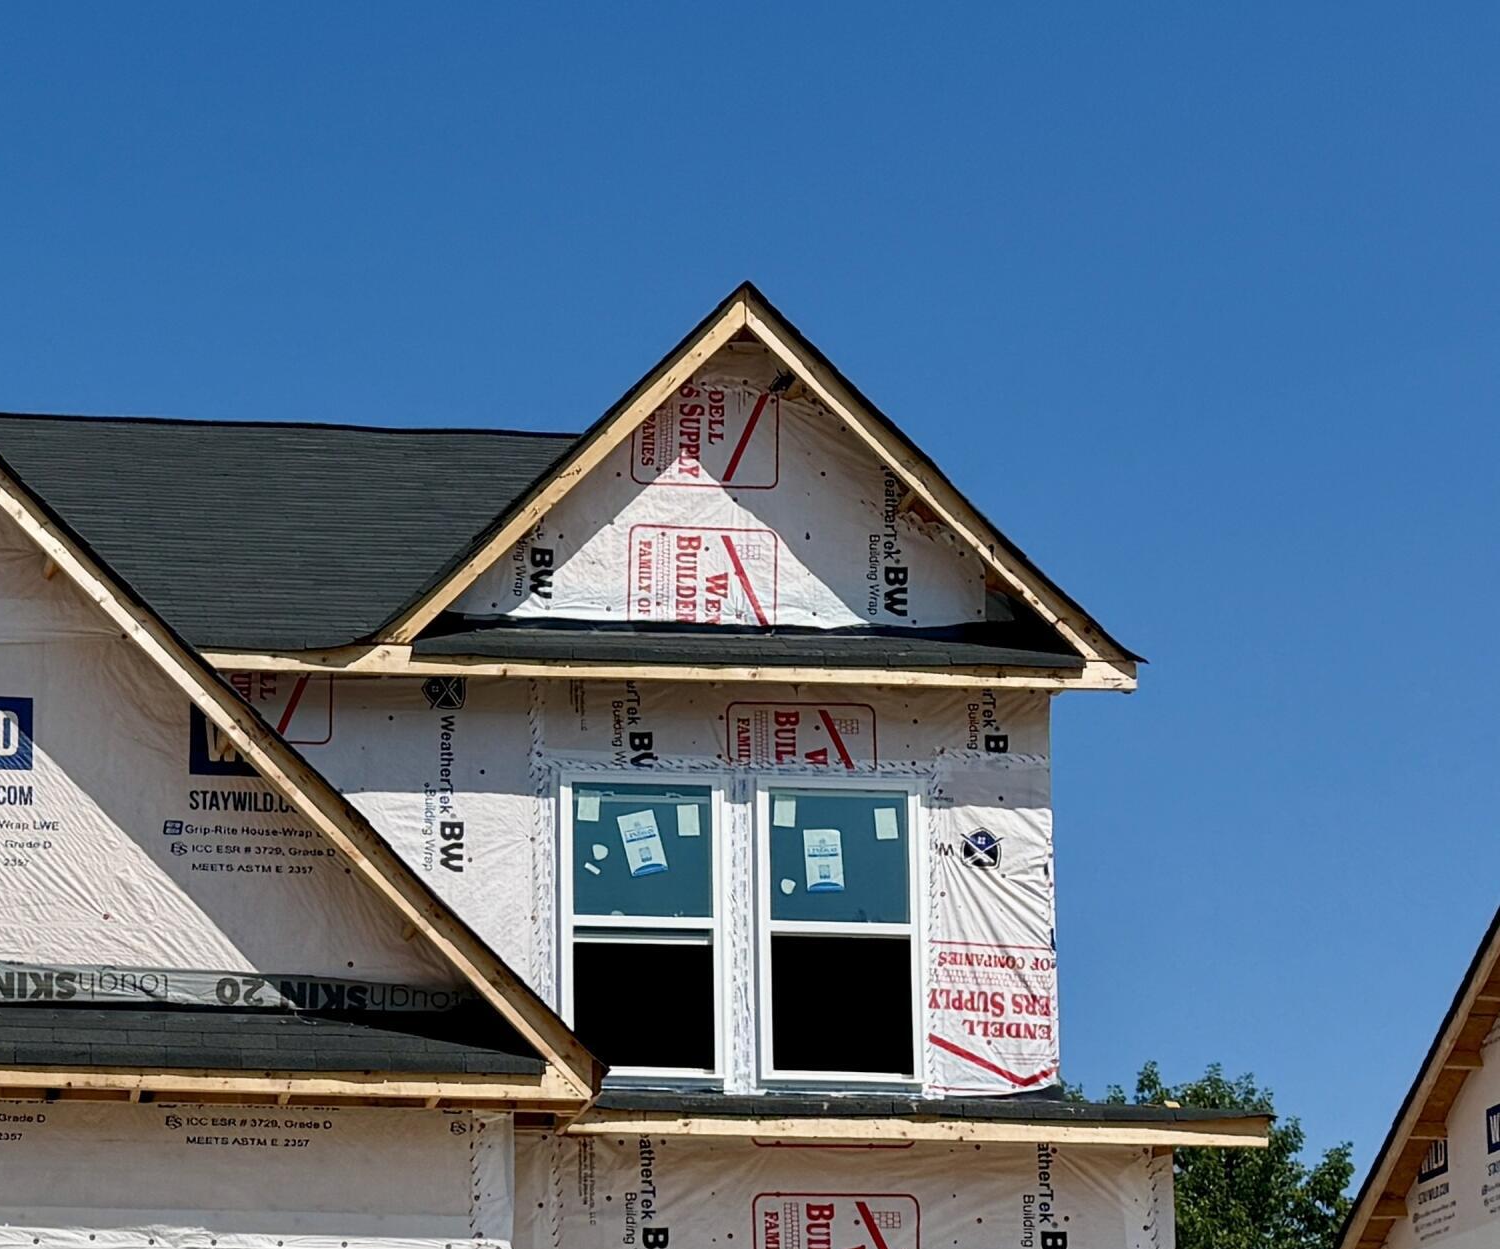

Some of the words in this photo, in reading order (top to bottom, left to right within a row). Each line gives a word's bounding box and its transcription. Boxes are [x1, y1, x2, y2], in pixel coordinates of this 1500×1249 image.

[679, 403, 704, 478] SUPPLY
[530, 548, 554, 599] BW
[639, 540, 652, 592] FAMILY
[867, 534, 880, 581] Building
[638, 597, 650, 616] OF
[868, 584, 879, 615] Wrap
[884, 566, 908, 617] BW
[612, 700, 623, 747] Building
[967, 703, 979, 750] Building
[440, 715, 454, 814] WeatherTek
[422, 788, 436, 836] Building
[422, 839, 435, 872] Wrap
[440, 822, 464, 872] BW
[938, 952, 1024, 971] COMPANIES
[216, 978, 264, 1005] 20
[928, 988, 1005, 1017] SUPPLY
[623, 1192, 637, 1244] Building
[1021, 1194, 1035, 1248] Building
